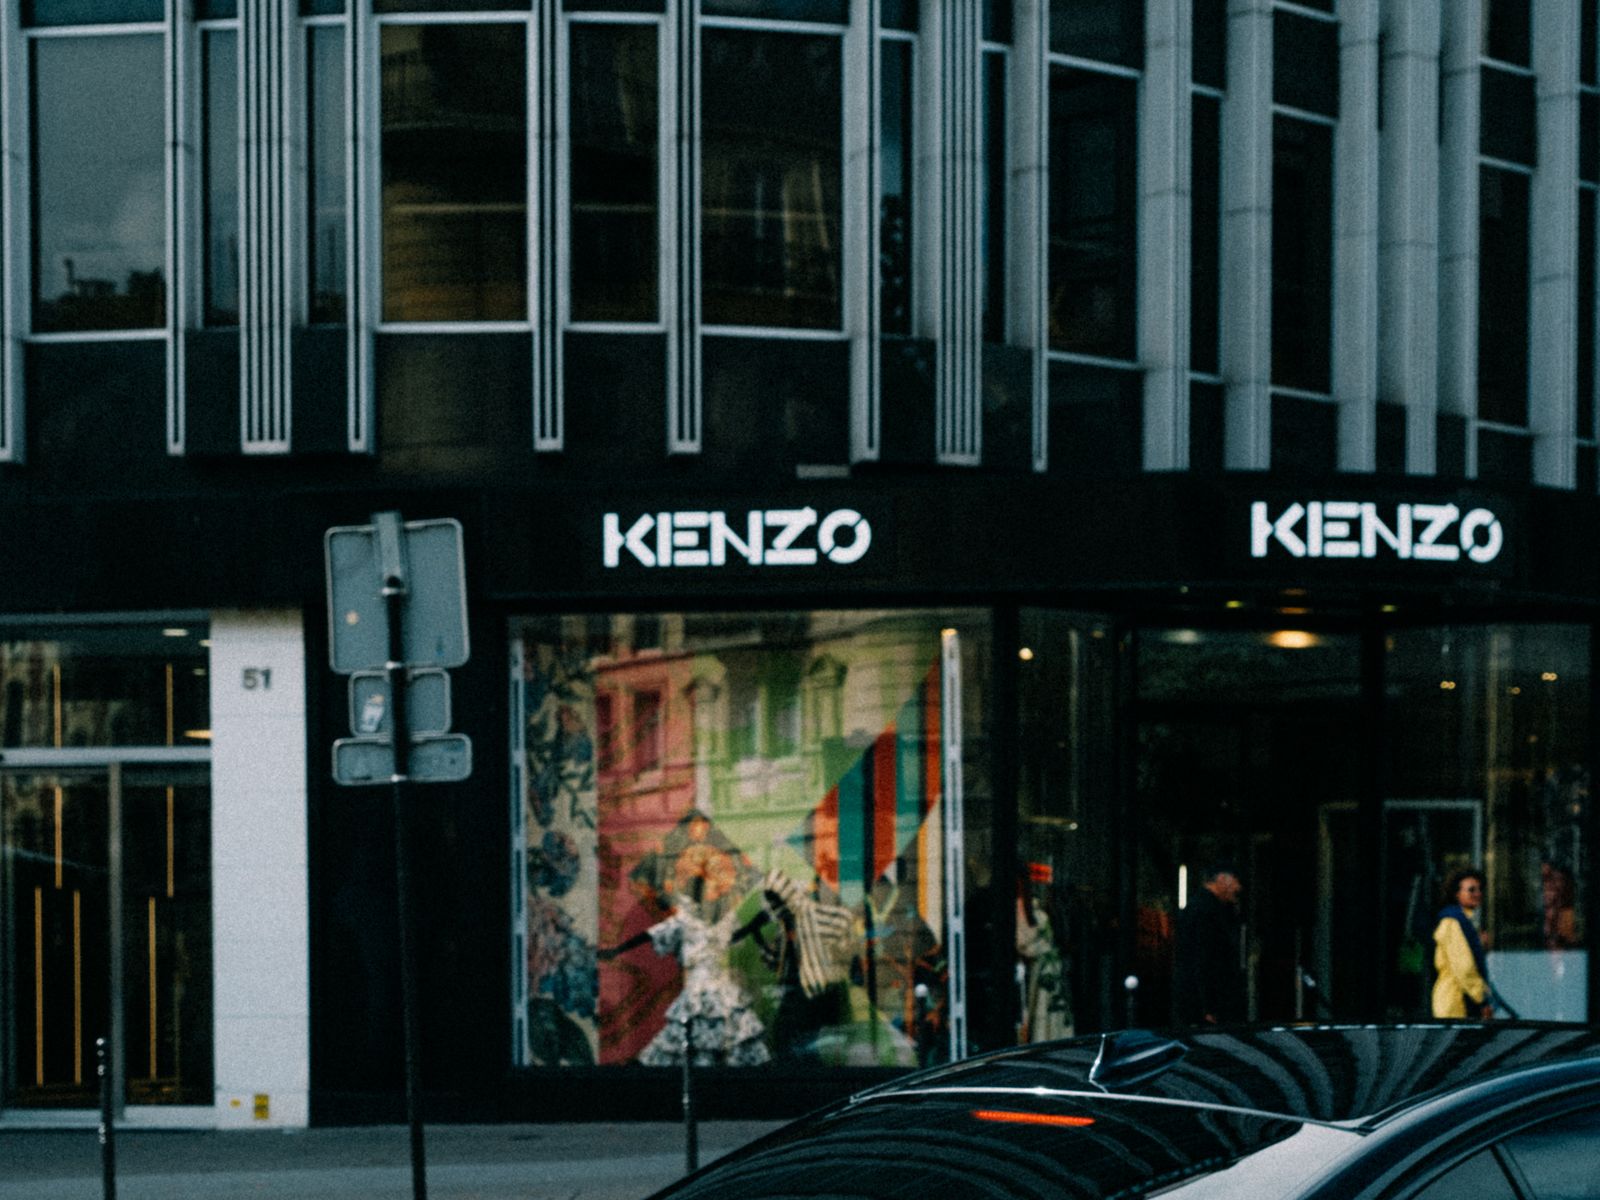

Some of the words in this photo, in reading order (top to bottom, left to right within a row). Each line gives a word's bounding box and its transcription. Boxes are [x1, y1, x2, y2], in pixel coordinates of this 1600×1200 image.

[603, 506, 872, 567] KENZO
[1251, 501, 1503, 563] KENZO
[243, 668, 271, 690] 51
